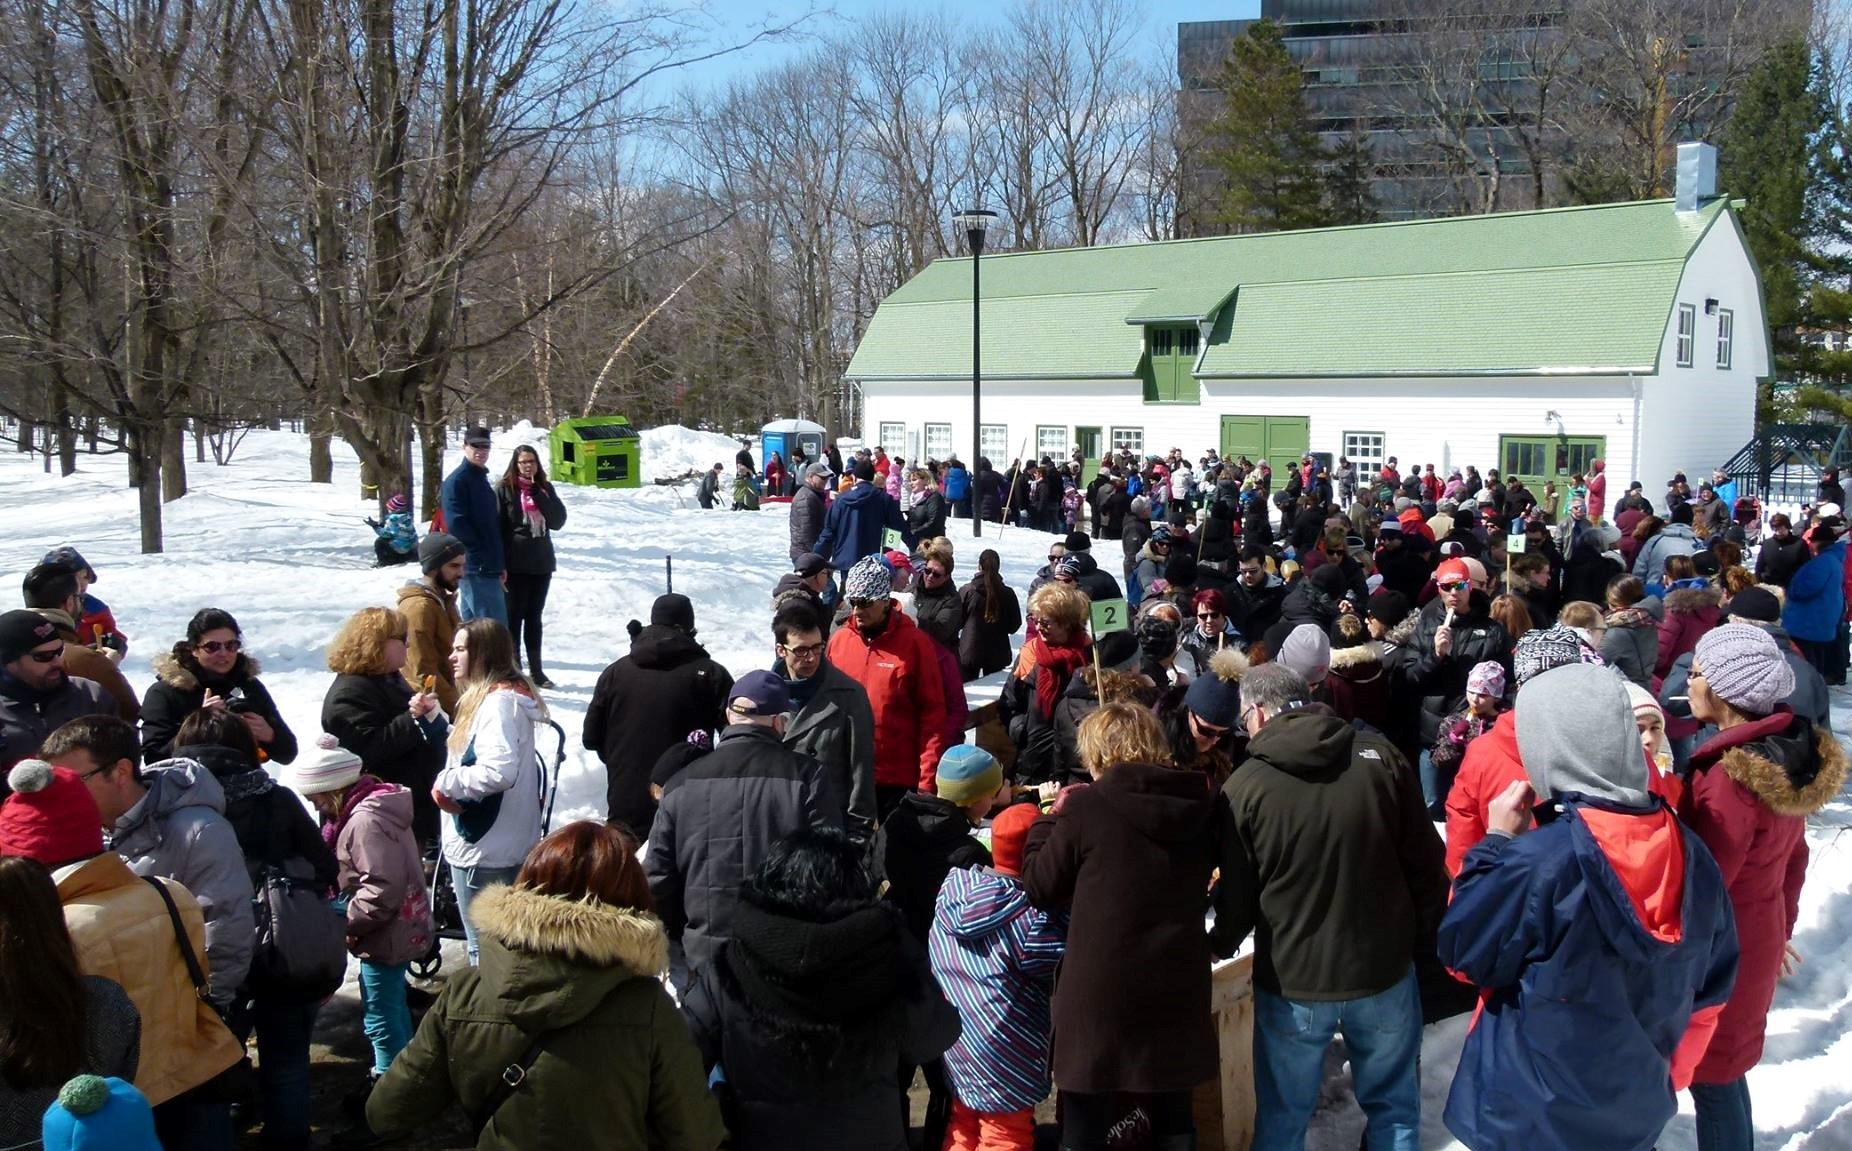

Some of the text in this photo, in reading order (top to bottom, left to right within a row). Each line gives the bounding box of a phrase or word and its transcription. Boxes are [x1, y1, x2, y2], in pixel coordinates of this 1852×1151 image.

[888, 533, 895, 544] 3
[1512, 538, 1519, 549] 4
[1104, 606, 1117, 625] 2
